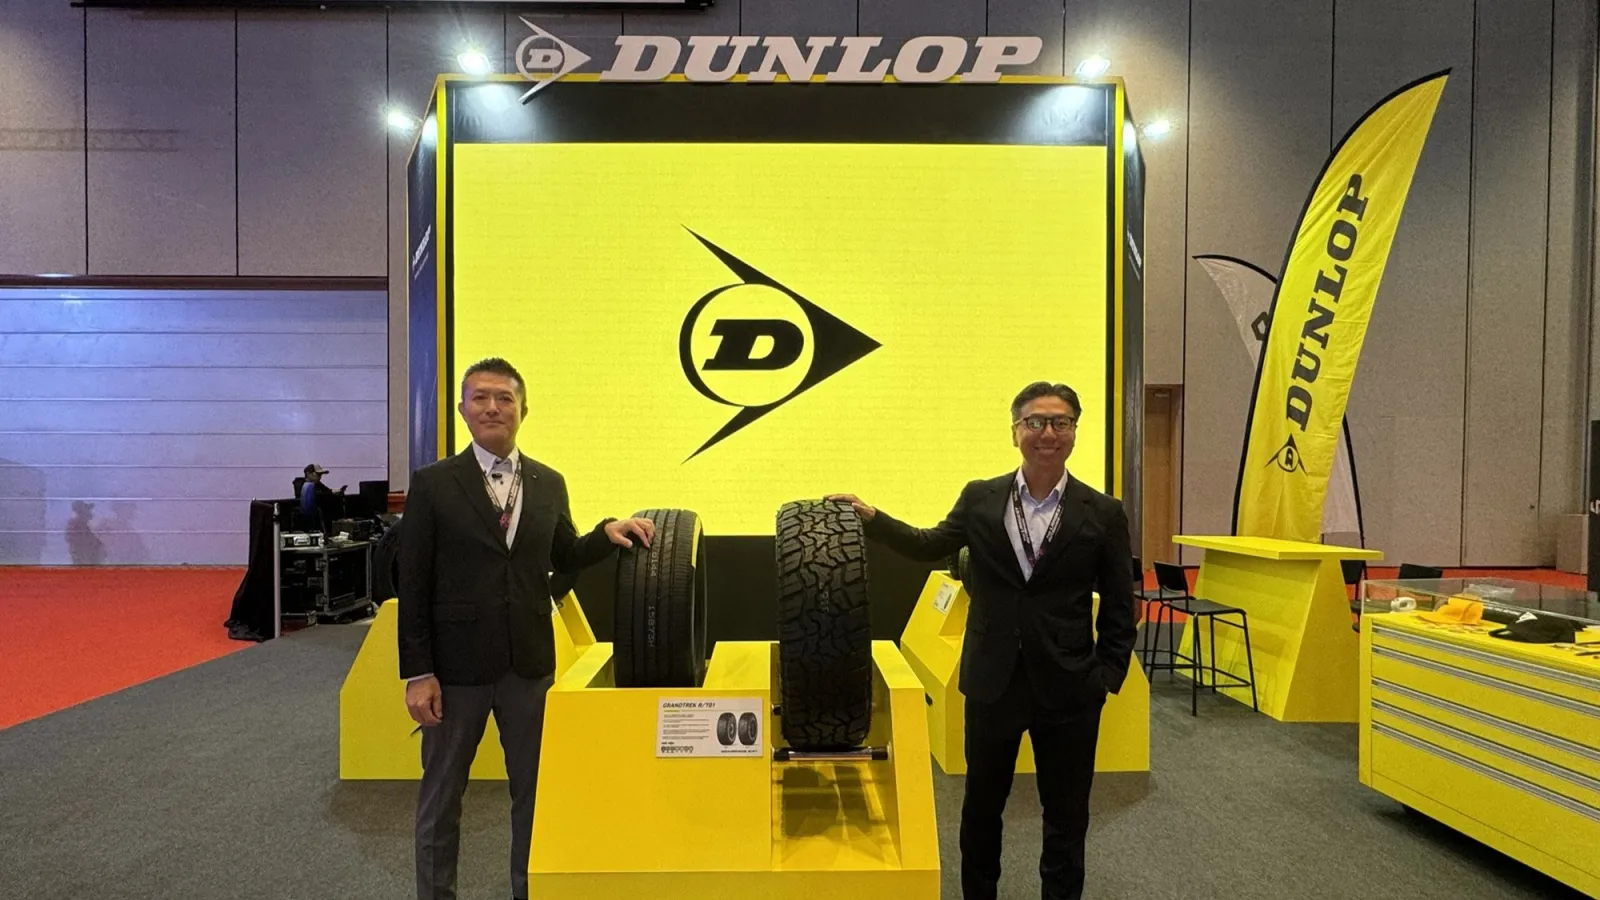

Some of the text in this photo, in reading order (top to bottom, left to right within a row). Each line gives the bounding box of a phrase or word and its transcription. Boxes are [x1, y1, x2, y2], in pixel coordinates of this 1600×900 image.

[600, 35, 1043, 83] DUNLOP
[1286, 173, 1369, 432] DUNLOP
[702, 319, 804, 370] D
